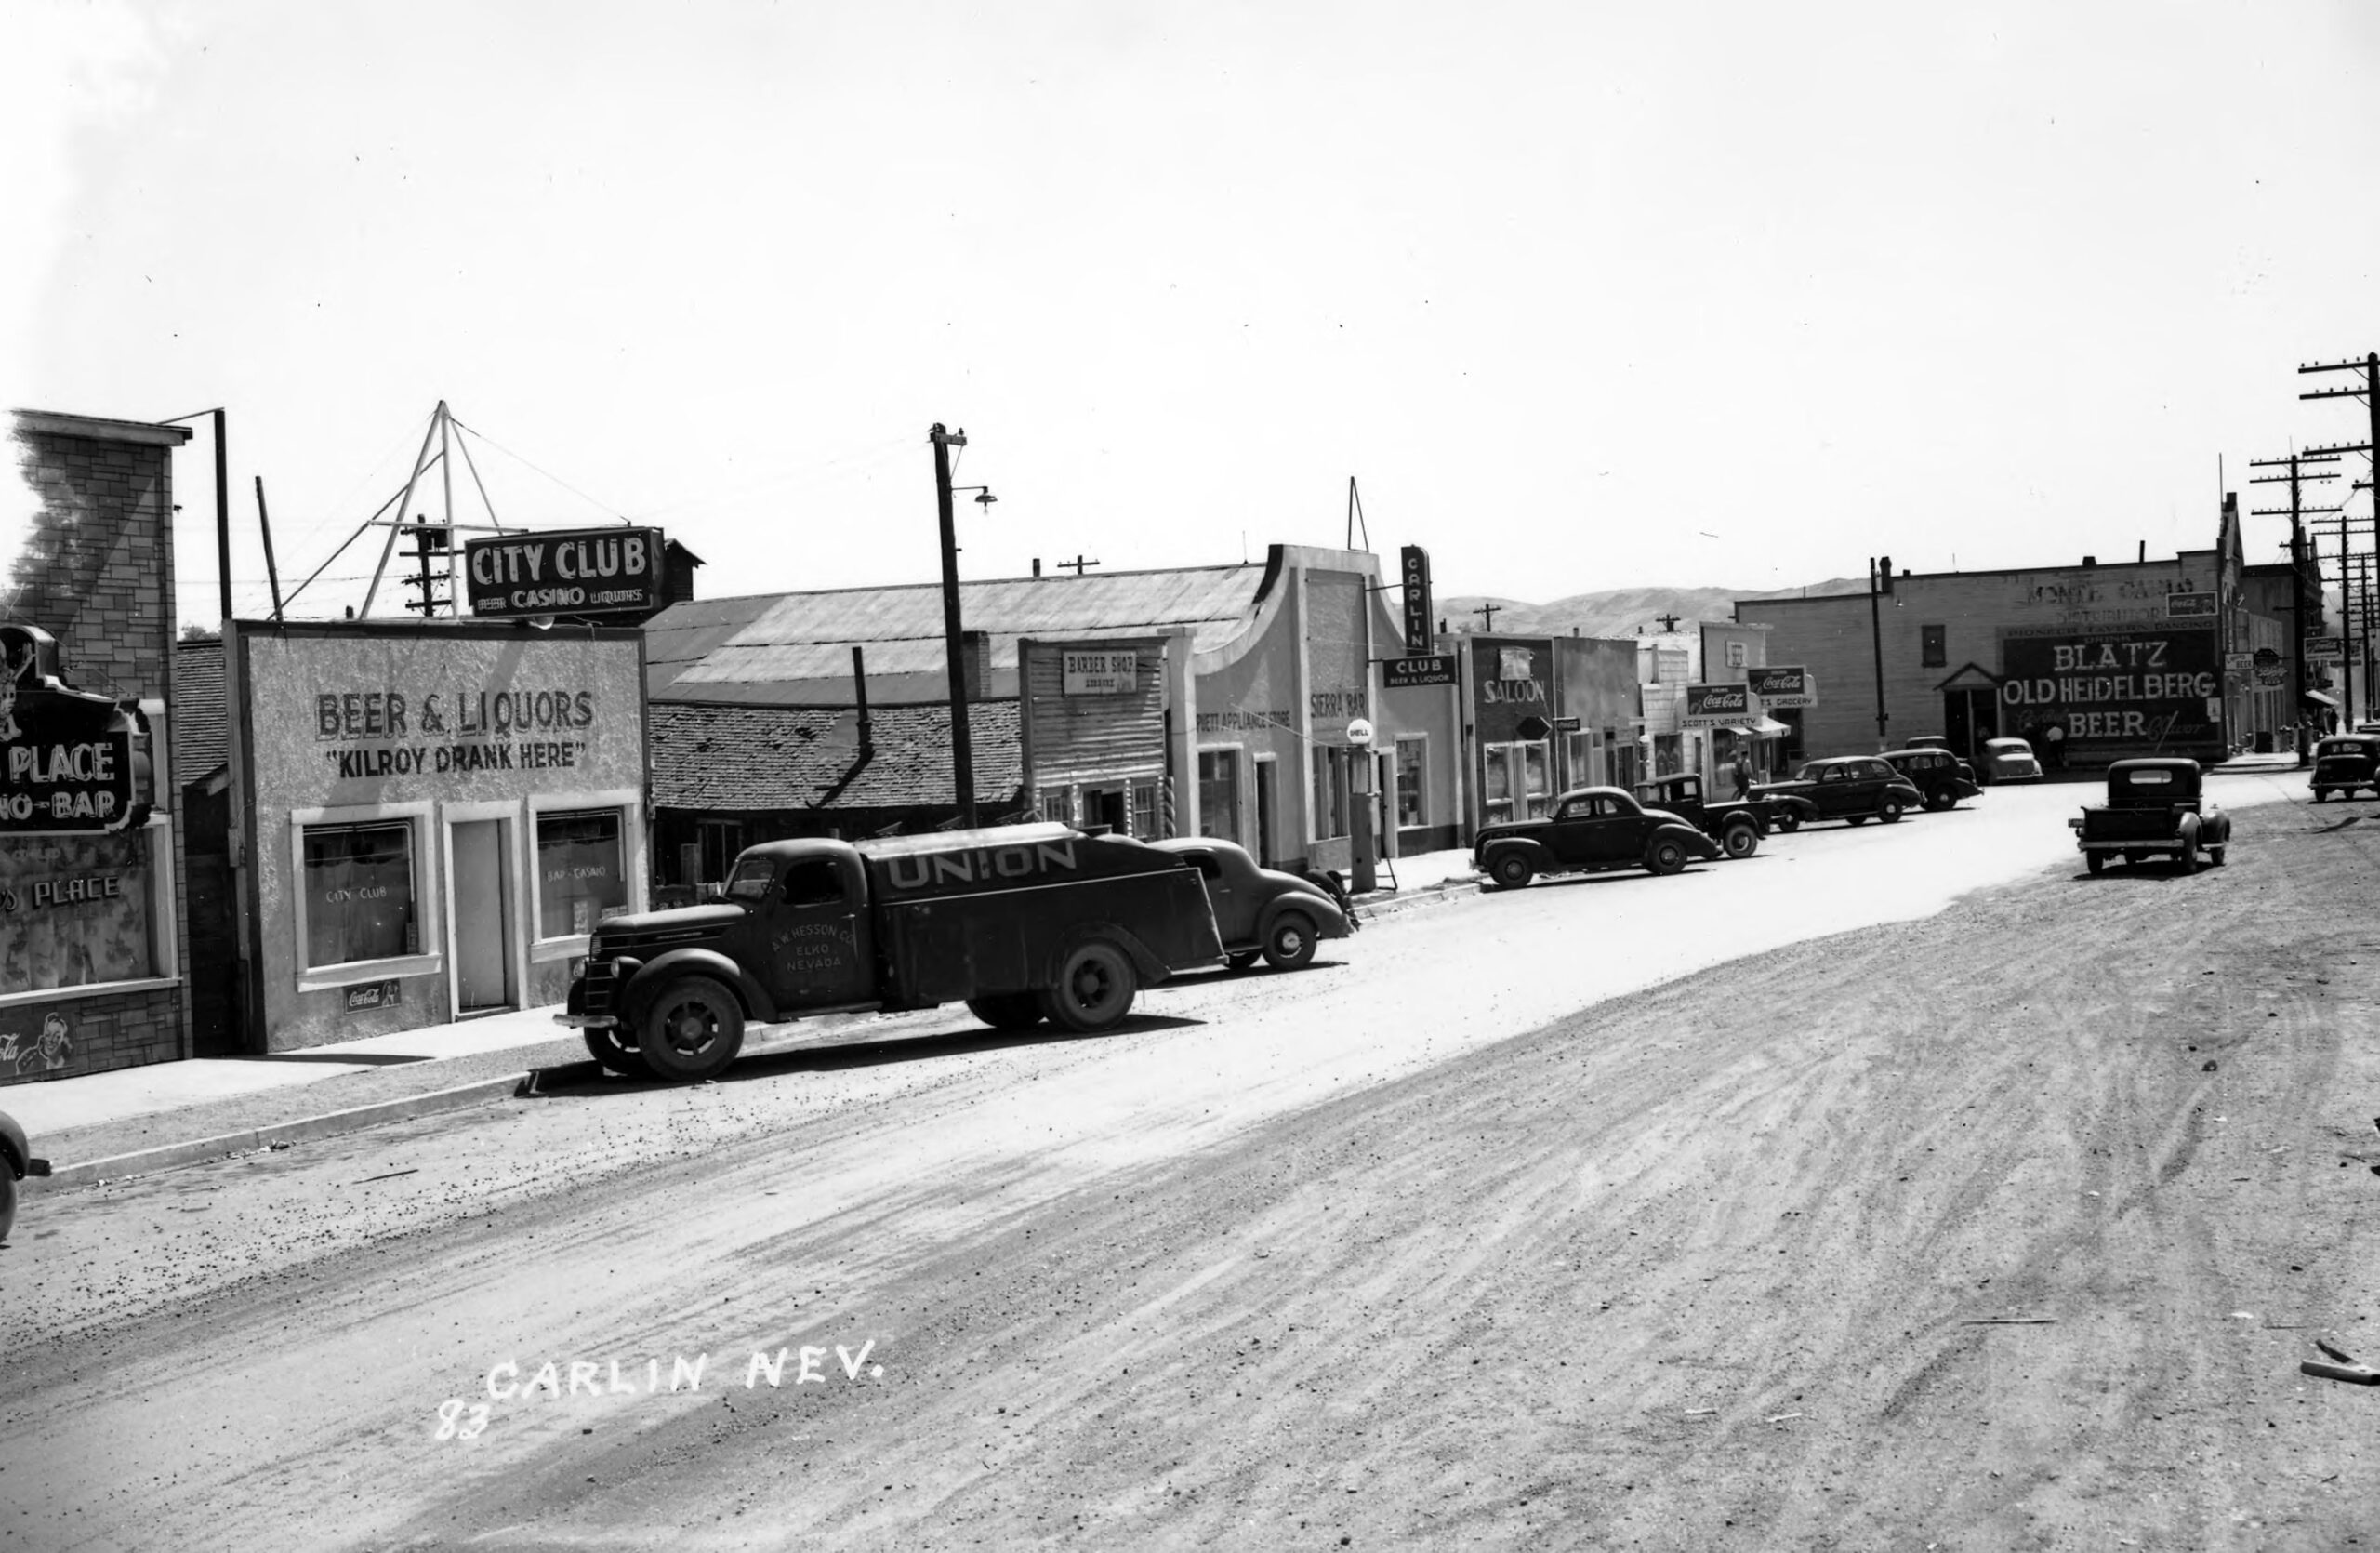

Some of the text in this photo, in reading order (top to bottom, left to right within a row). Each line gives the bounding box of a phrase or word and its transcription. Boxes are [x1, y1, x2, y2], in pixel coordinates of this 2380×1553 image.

[472, 537, 647, 586] CITY CLUB
[511, 586, 586, 608] CASINO
[1408, 558, 1424, 647] CARLIN
[2007, 619, 2215, 638] PIONEER TAVERN DANCING
[1067, 656, 1133, 674] BARBER SHOP
[1396, 659, 1442, 674] CLUB
[2053, 641, 2169, 671] BLATZ
[1483, 679, 1545, 704] SALOON
[1763, 675, 1802, 689] Coca-Cola
[2003, 672, 2216, 705] OLD HEIDELBERG
[1310, 692, 1367, 718] SIERRA BAR
[1703, 693, 1745, 709] Coca-Cola
[1777, 697, 1813, 706] GROCERY
[315, 690, 595, 742] BEER & LIQUORS
[1720, 717, 1756, 726] VARIETY
[2067, 710, 2147, 737] BEER
[9, 743, 115, 782] PLACE
[326, 742, 586, 778] "KILROY DRANK HERE"
[0, 790, 117, 820] NO-BAR
[888, 841, 1077, 889] UNION
[33, 875, 120, 909] PLACE
[326, 885, 388, 904] CITY CLUB
[791, 923, 838, 939] HESSON
[796, 943, 830, 956] ELKO
[787, 956, 842, 972] NEVADA
